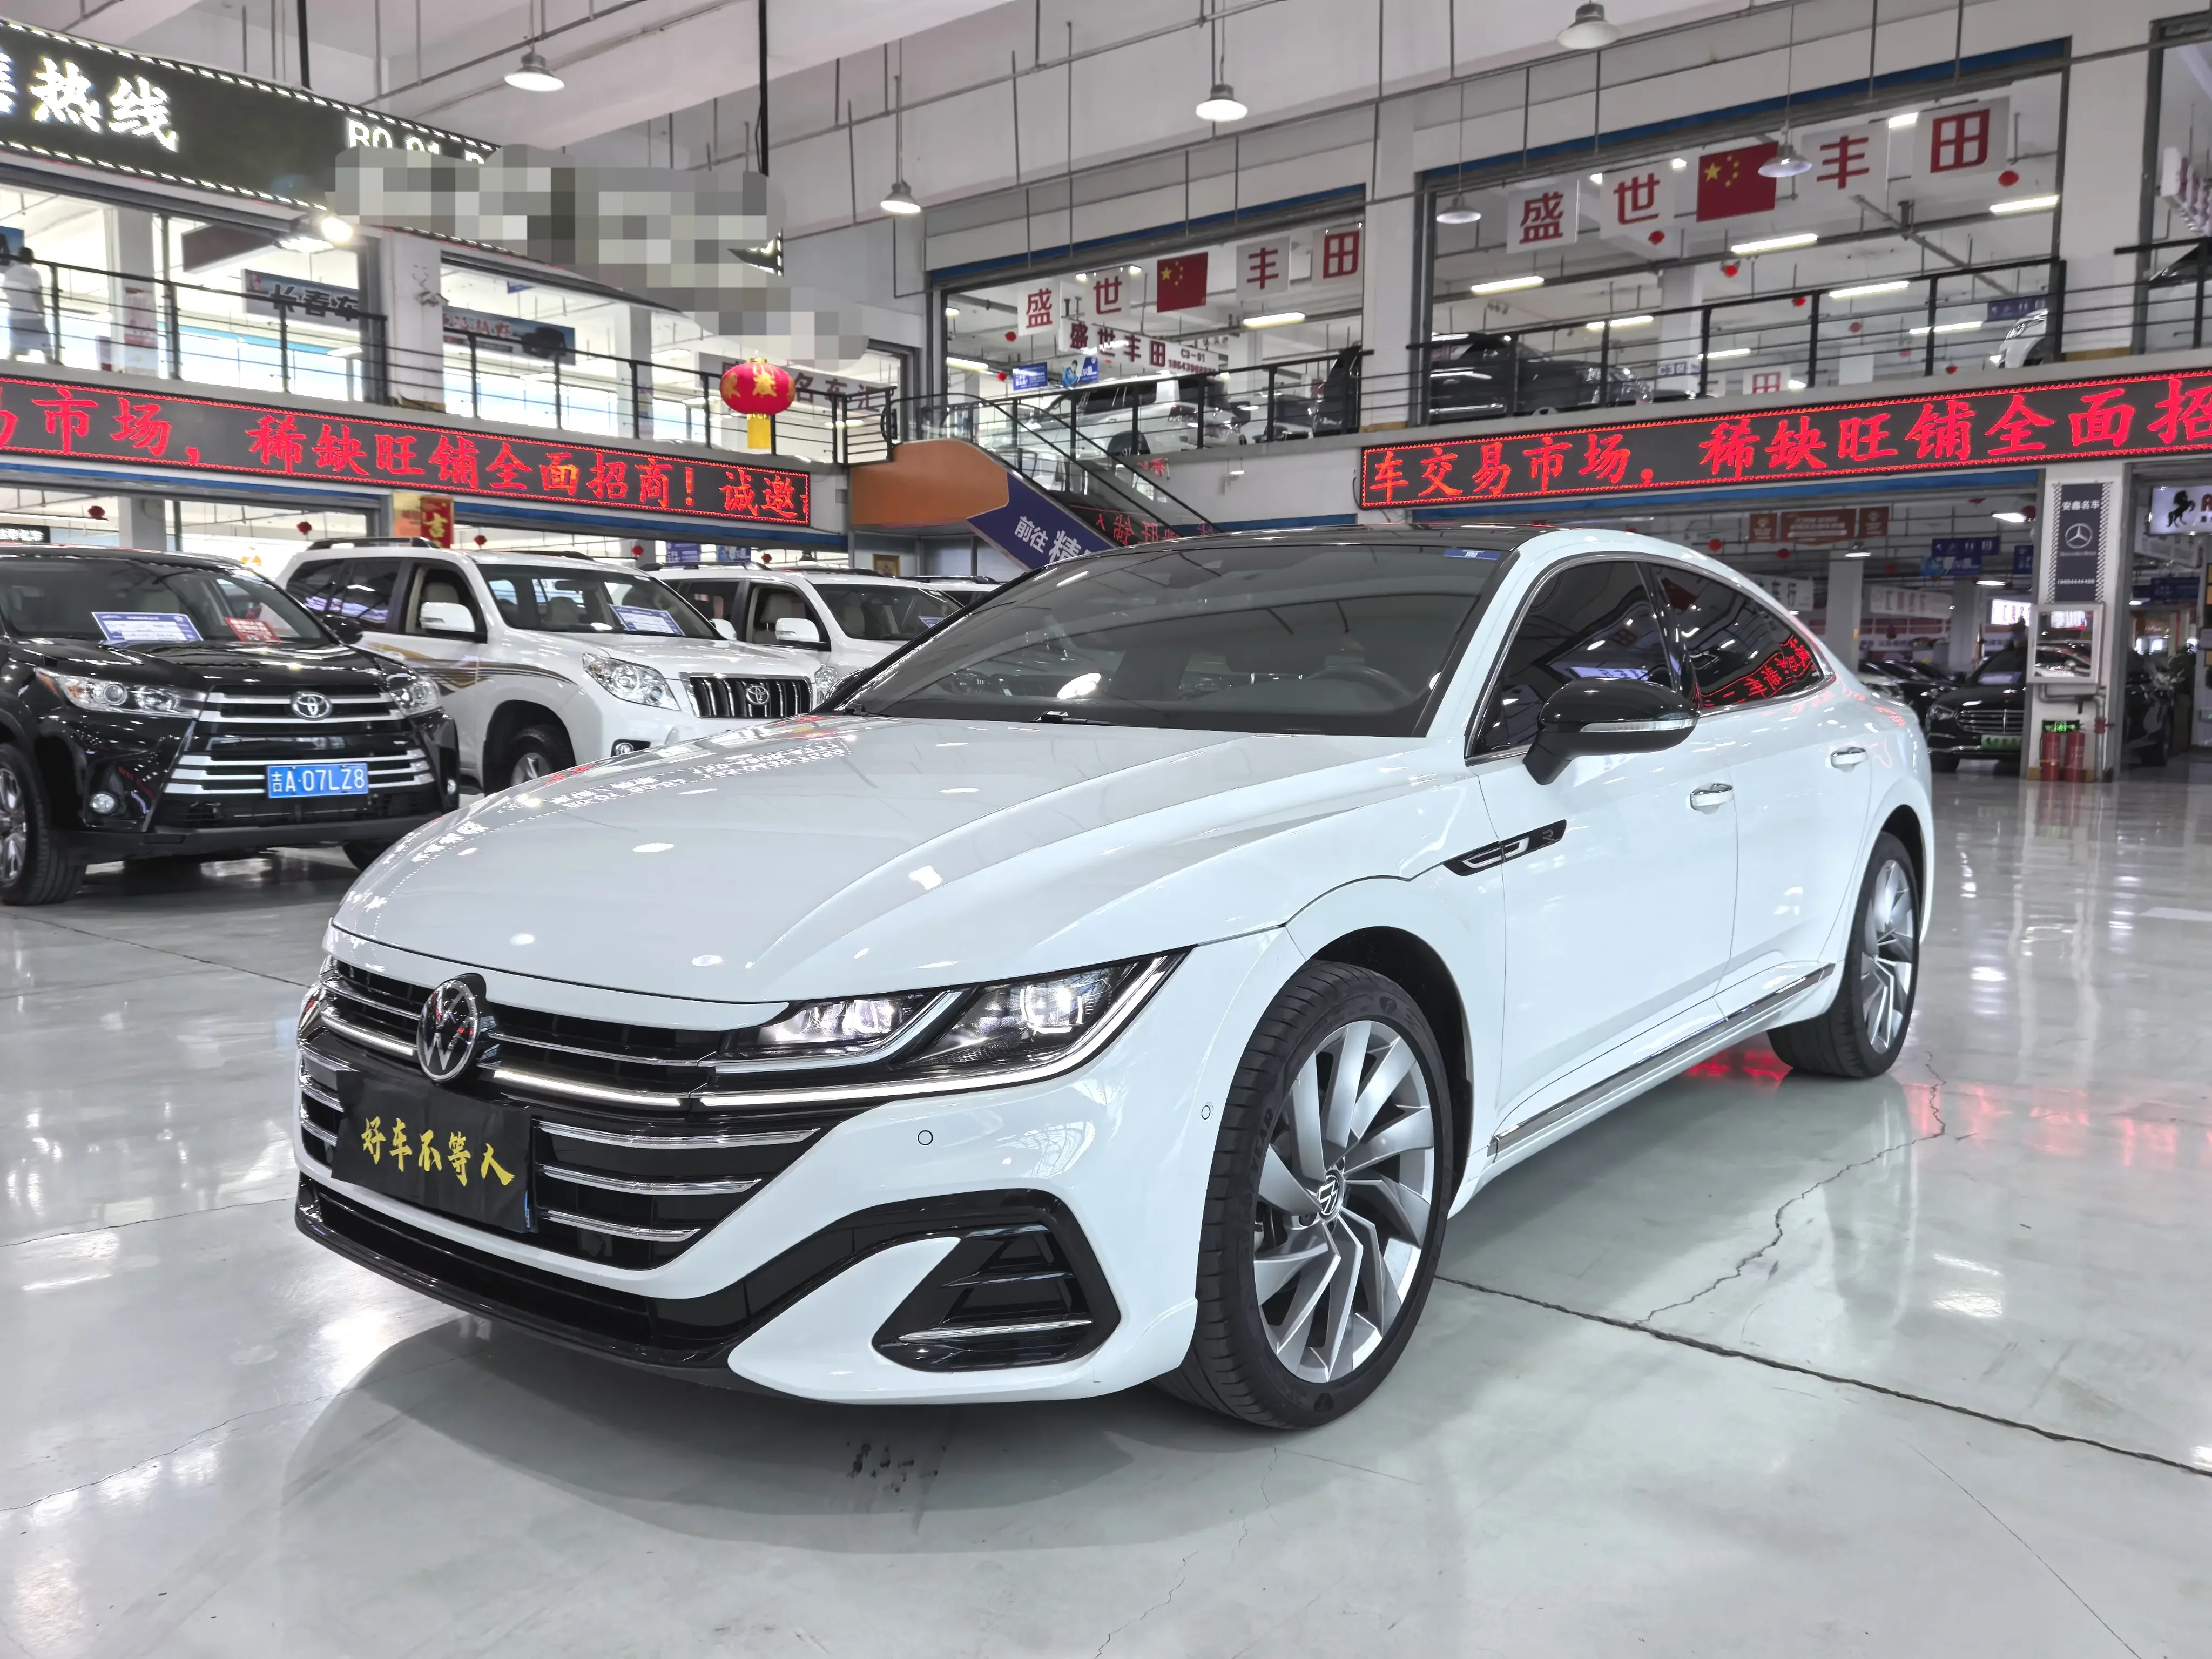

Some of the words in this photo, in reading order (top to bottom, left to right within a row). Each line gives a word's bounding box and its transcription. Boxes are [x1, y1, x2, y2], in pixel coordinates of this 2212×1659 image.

[1015, 516, 1048, 554] 前往
[361, 1115, 515, 1187] 好车不等人
